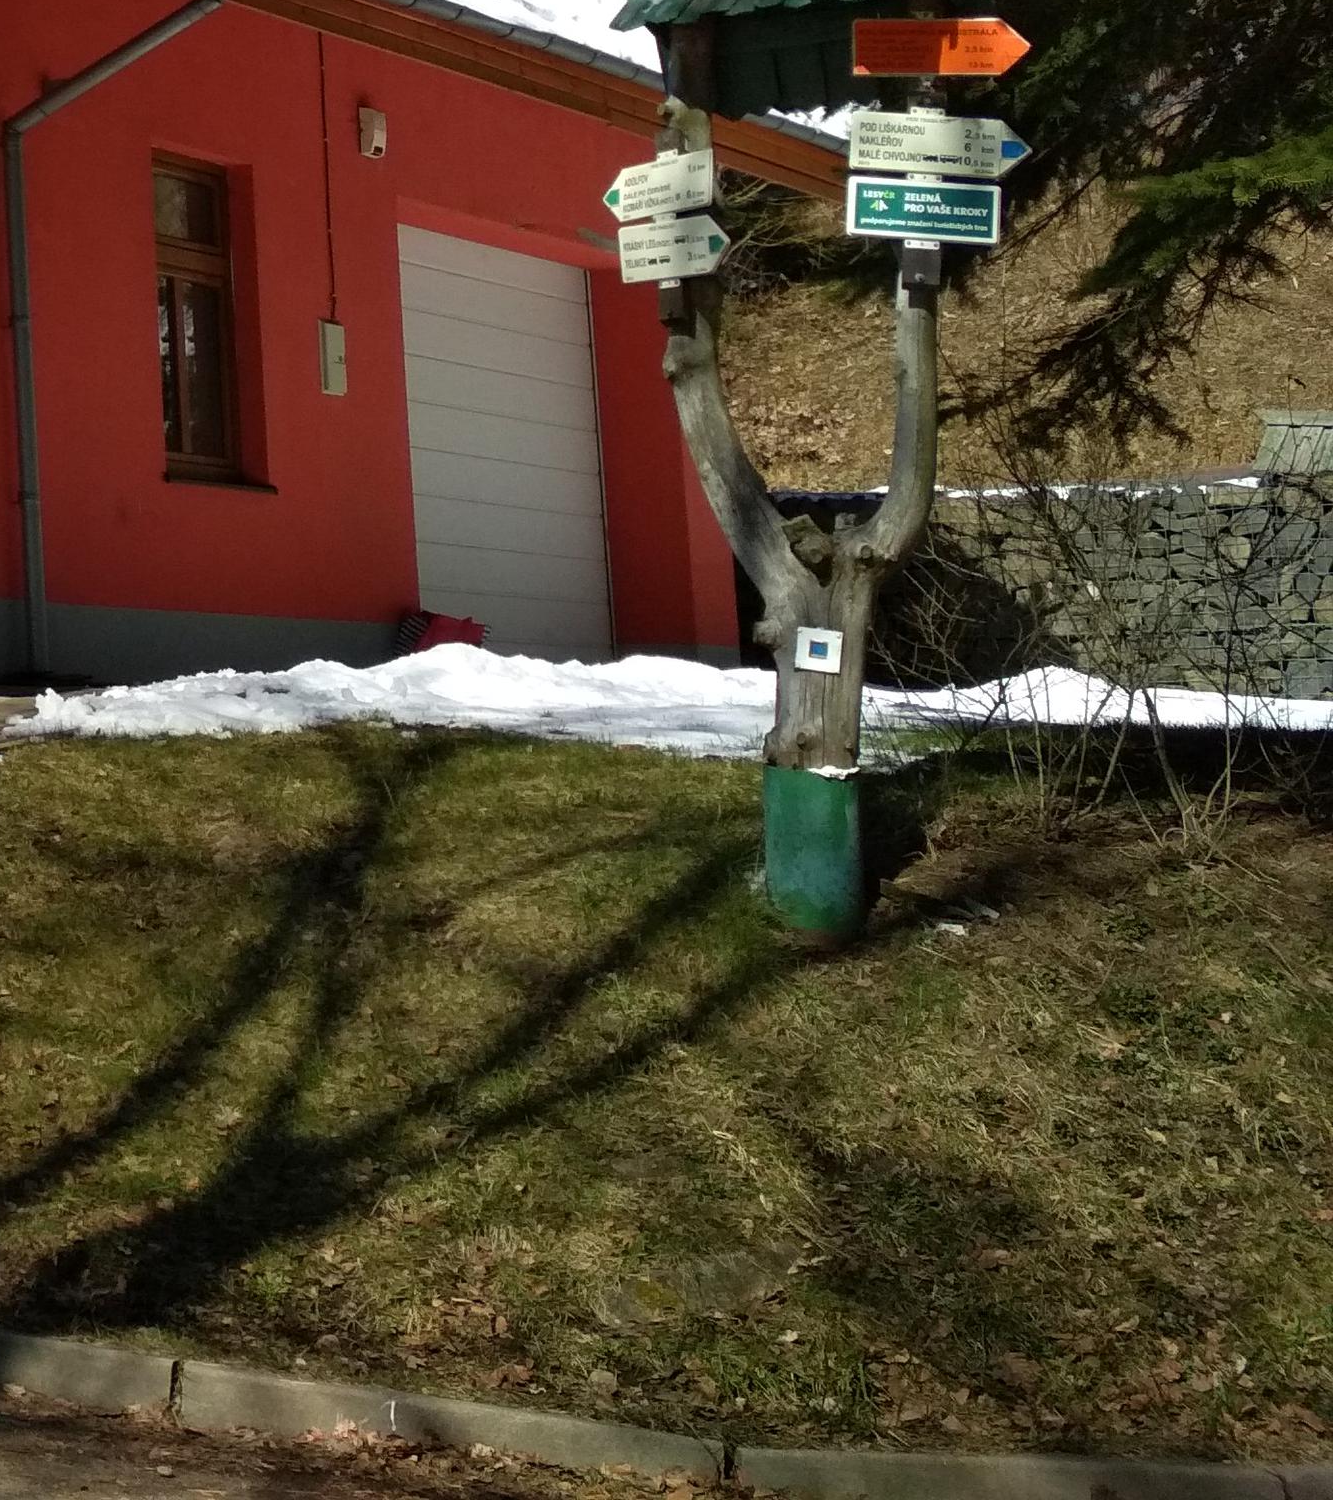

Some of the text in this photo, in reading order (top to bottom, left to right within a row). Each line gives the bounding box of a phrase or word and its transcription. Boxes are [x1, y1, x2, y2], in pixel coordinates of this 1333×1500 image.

[860, 122, 877, 132] POD
[964, 143, 972, 152] 6
[904, 192, 942, 203] ZELENÁ
[904, 204, 988, 217] PRO VAŠE KROKY
